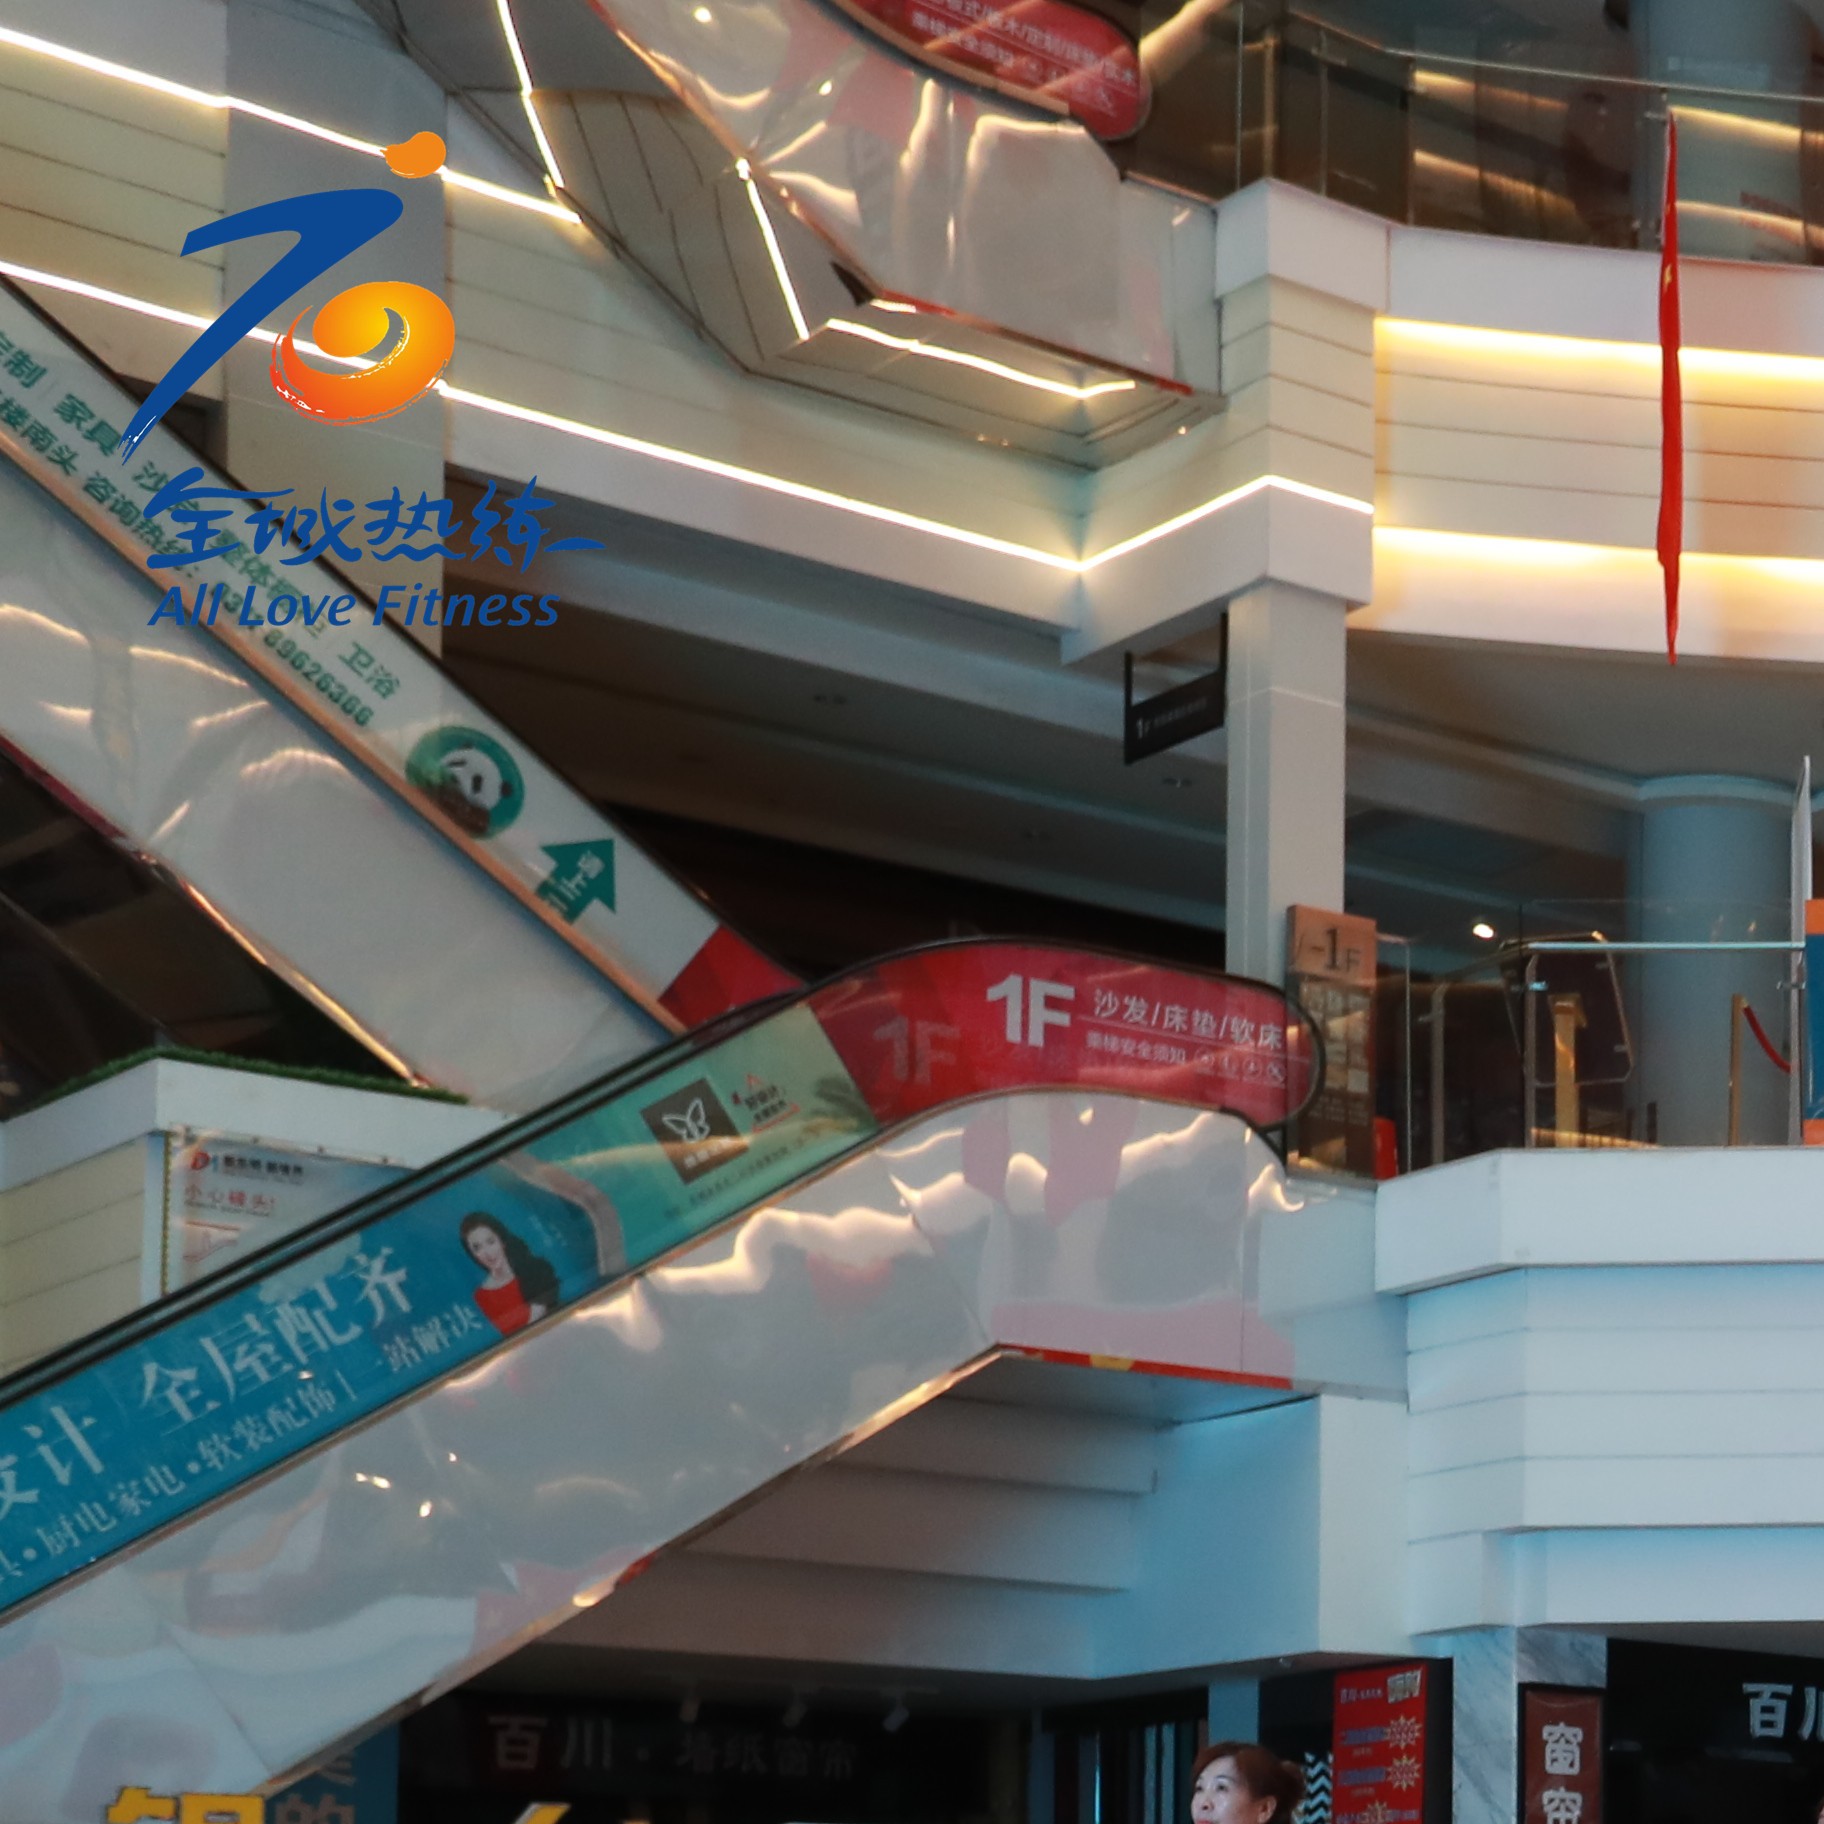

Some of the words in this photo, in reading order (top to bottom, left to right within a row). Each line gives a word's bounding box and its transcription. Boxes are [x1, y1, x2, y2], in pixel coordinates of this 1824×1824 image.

[986, 974, 1075, 1048] 1F
[1093, 988, 1284, 1051] 沙发/床垫/软床
[138, 1245, 416, 1427] 全屋配齐
